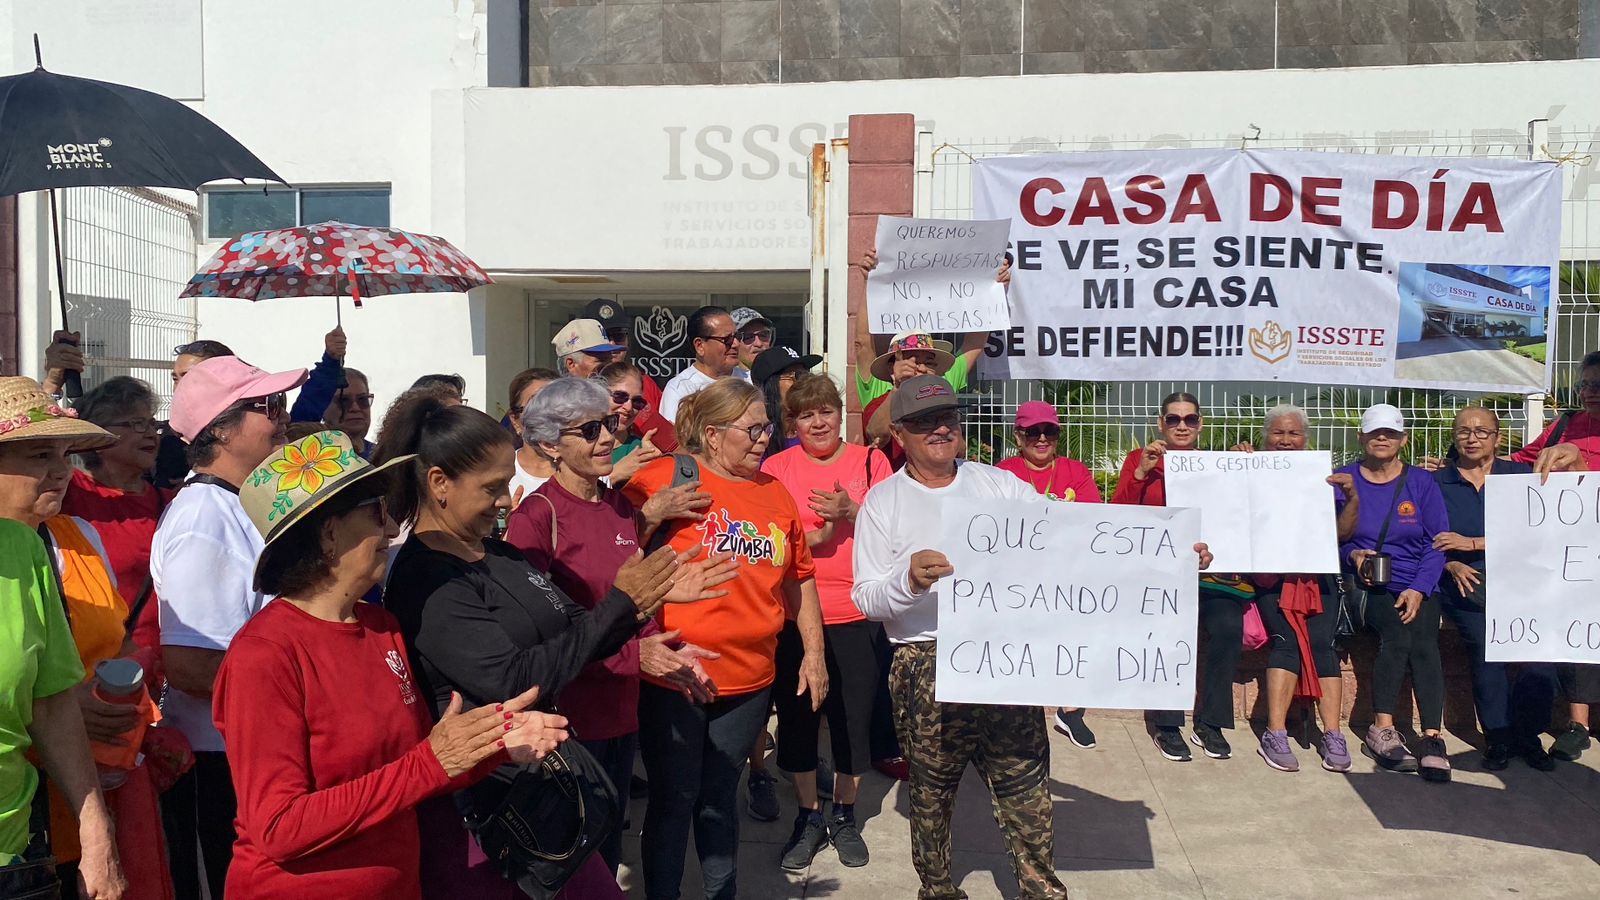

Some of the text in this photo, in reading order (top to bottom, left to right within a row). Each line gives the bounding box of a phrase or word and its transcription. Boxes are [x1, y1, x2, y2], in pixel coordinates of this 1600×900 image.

[47, 143, 99, 154] MONT
[50, 152, 104, 164] BLANC
[46, 162, 112, 170] PARFUMS
[1018, 168, 1505, 233] CASA DE DÍA
[896, 224, 977, 240] QUEREMOS
[896, 250, 1001, 271] RESPUESTAS
[1058, 239, 1129, 273] VE,
[1136, 237, 1196, 269] SE
[1213, 235, 1393, 275] SIENTE.
[892, 281, 975, 301] NO, NO
[1082, 276, 1279, 310] MI CASA
[1448, 286, 1477, 299] ISSSTE
[1487, 295, 1513, 309] CASA
[1515, 301, 1524, 310] DE
[1525, 302, 1537, 312] DÍA
[1037, 324, 1244, 358] DEFIENDE!!!
[1297, 326, 1385, 346] ISSSTE
[1169, 454, 1291, 473] SRES GESTORES
[1527, 475, 1600, 527] DÓ
[967, 508, 1177, 558] QUÉ ESTÁ
[715, 534, 774, 560] ZUMBA
[953, 578, 1179, 615] PASANDO EN
[1490, 617, 1541, 645] LOS
[950, 632, 1192, 686] CASA DE DÍA?
